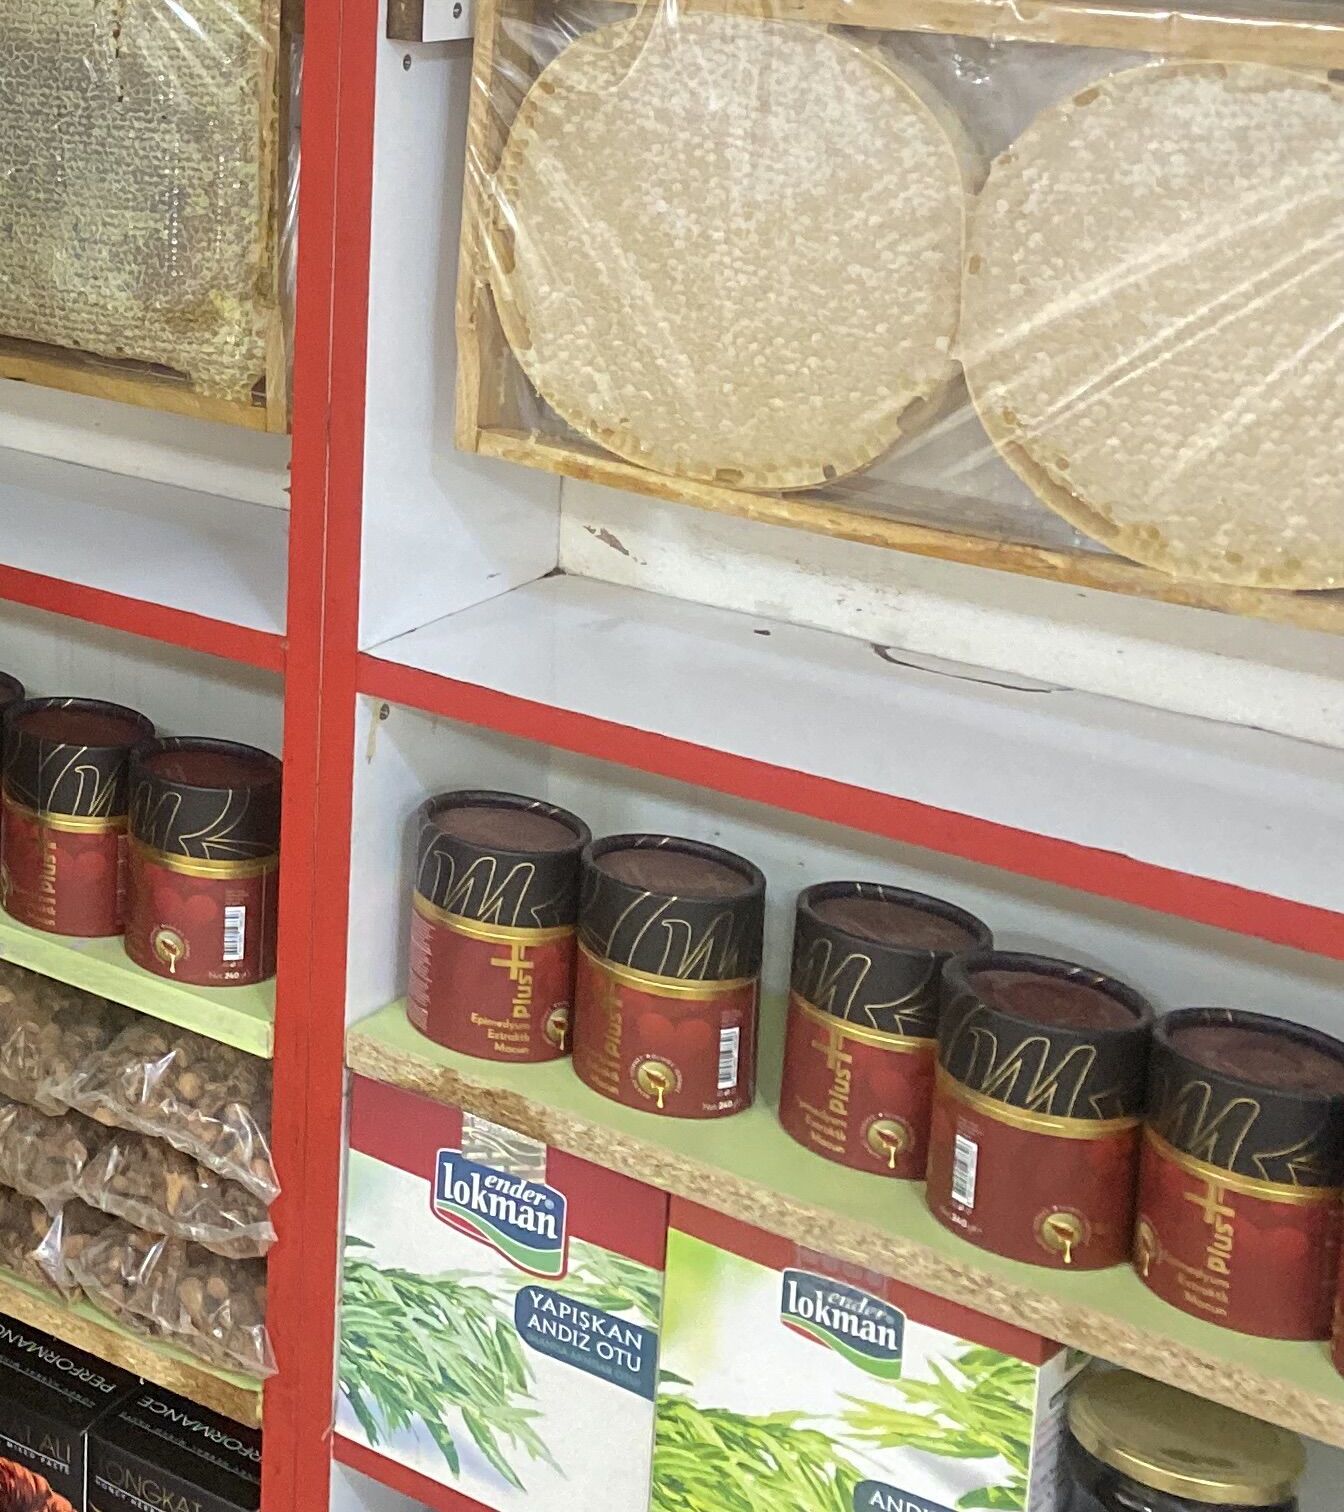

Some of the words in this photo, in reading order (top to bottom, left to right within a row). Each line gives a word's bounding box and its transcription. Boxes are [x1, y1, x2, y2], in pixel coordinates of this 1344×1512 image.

[442, 1162, 559, 1240] lokman
[484, 1174, 548, 1207] ender
[529, 1289, 643, 1351] YAPIŞKAN
[787, 1280, 899, 1351] lokman
[827, 1290, 889, 1319] ender
[527, 1313, 592, 1353] ANDIZ
[596, 1340, 642, 1373] OTU
[137, 1395, 263, 1464] RFORMANCE
